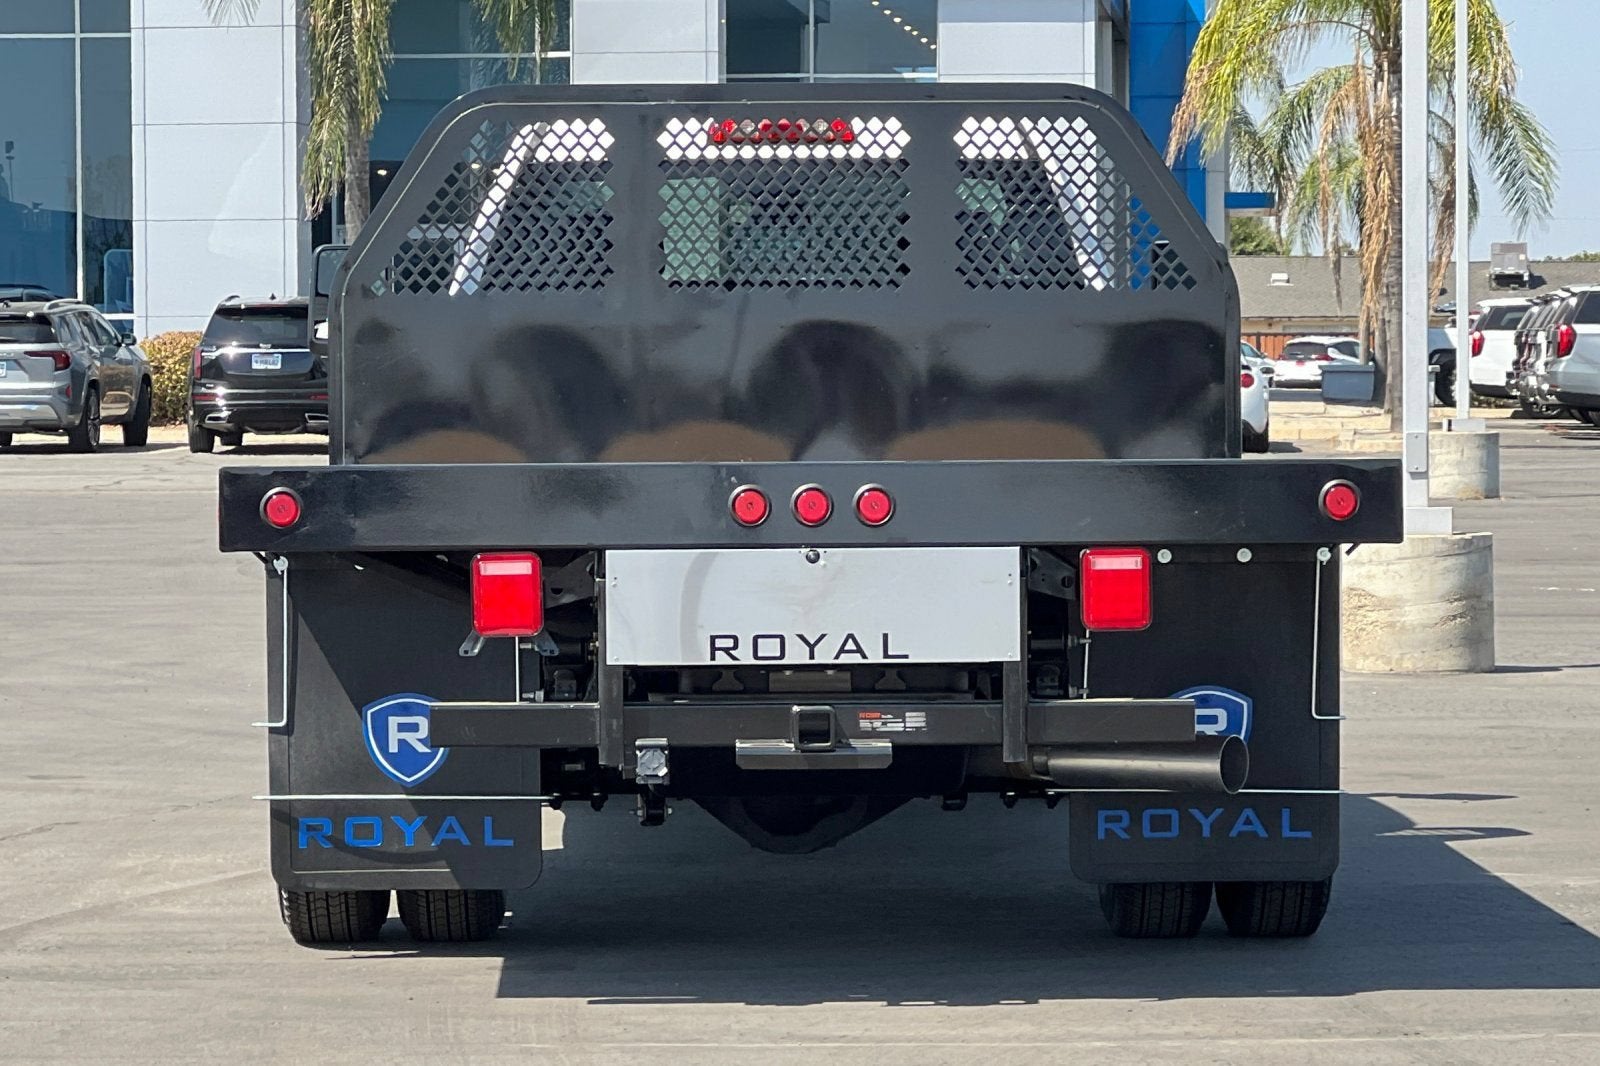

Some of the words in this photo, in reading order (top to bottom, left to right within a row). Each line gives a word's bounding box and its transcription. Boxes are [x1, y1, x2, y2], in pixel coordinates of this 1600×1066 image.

[710, 633, 909, 661] ROYAL
[388, 716, 431, 753] R
[298, 816, 514, 848] ROYAL
[1098, 808, 1312, 839] ROYAL
